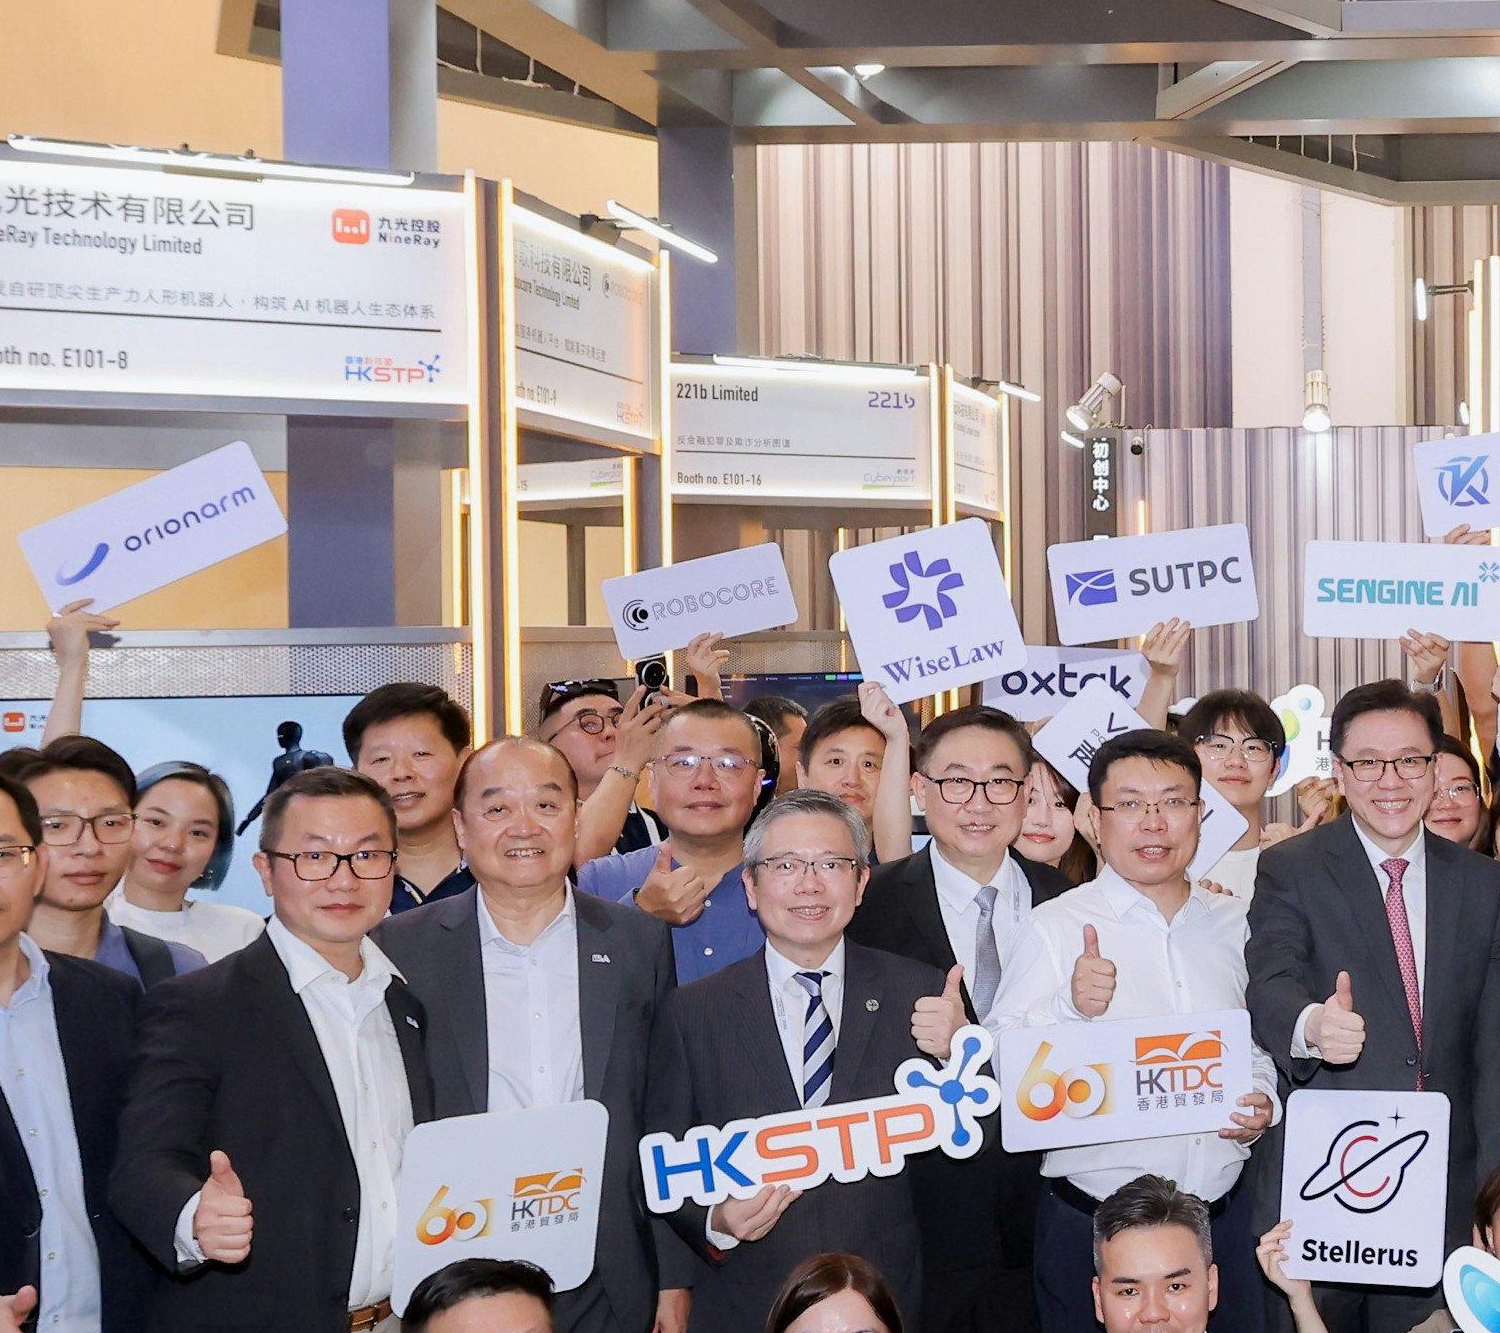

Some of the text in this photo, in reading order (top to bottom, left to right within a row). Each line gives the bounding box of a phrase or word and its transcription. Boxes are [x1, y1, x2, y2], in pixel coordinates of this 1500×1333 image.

[378, 215, 440, 235] 九光控股
[378, 231, 440, 249] NineRay
[43, 226, 138, 256] Technology
[142, 233, 203, 256] Limited
[292, 297, 436, 321] AI 机器人生态体系
[533, 279, 580, 311] Technology Limited
[28, 348, 57, 367] no.
[62, 348, 129, 370] E101-8
[345, 363, 424, 383] HKSTP
[676, 383, 759, 402] 221b Limited
[677, 472, 762, 486] Booth no. E101-16
[863, 473, 916, 487] Cyberport
[1092, 442, 1110, 512] 初创中心
[124, 484, 257, 553] orionarm
[1129, 556, 1242, 598] SUTPC
[651, 575, 780, 622] ROBOCORE
[1316, 577, 1480, 608] SENGINE AI
[881, 639, 1006, 688] WiseLaw
[1136, 1063, 1224, 1095] HKTDC
[1136, 1090, 1225, 1113] 香港貿發局
[651, 1102, 935, 1201] HKSTP
[511, 1190, 580, 1221] HKTDC
[510, 1211, 580, 1233] 香港貿發局
[1301, 1238, 1419, 1268] Stellerus
